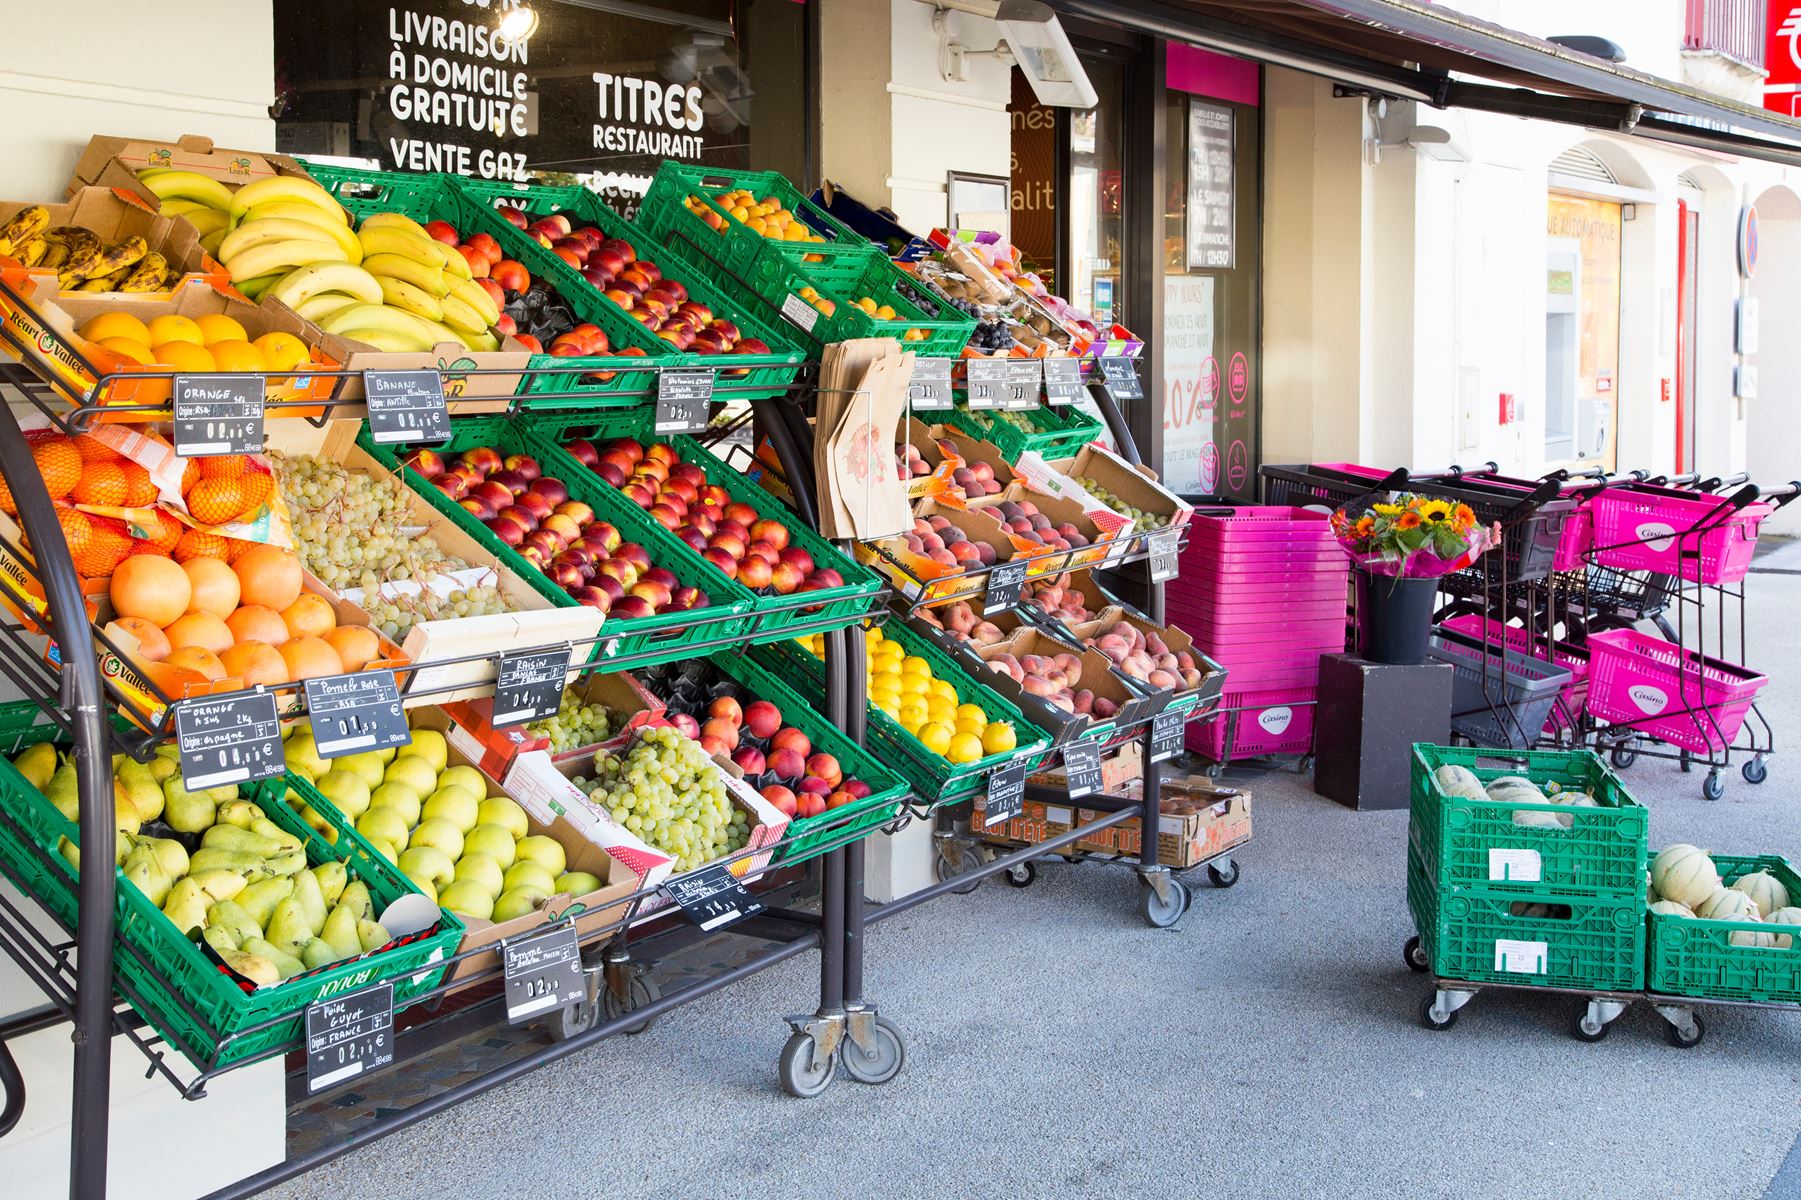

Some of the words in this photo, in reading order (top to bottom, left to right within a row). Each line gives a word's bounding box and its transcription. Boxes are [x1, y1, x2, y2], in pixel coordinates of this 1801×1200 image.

[390, 8, 528, 65] LIVRAISON
[390, 42, 406, 80] À
[414, 54, 528, 101] DOMICILE
[593, 72, 704, 132] TITRES
[390, 84, 528, 137] GRATUITE
[1012, 104, 1055, 130] nés
[593, 124, 704, 160] RESTAURANT
[390, 137, 474, 176] VENTE
[478, 149, 531, 182] GAZ
[1011, 181, 1055, 211] alit
[1165, 284, 1178, 304] PPY
[10, 311, 40, 340] Réart
[376, 379, 417, 391] BANANE
[184, 388, 231, 399] ORANGE
[432, 412, 441, 423] €
[246, 423, 255, 435] €
[320, 677, 358, 694] Pomelo
[555, 680, 563, 692] €
[1633, 690, 1664, 705] Casino
[193, 702, 235, 717] ORANGE
[390, 703, 401, 717] €
[1262, 713, 1289, 724] Casino
[262, 743, 273, 756] €
[571, 960, 580, 973] €
[375, 1034, 385, 1047] €
